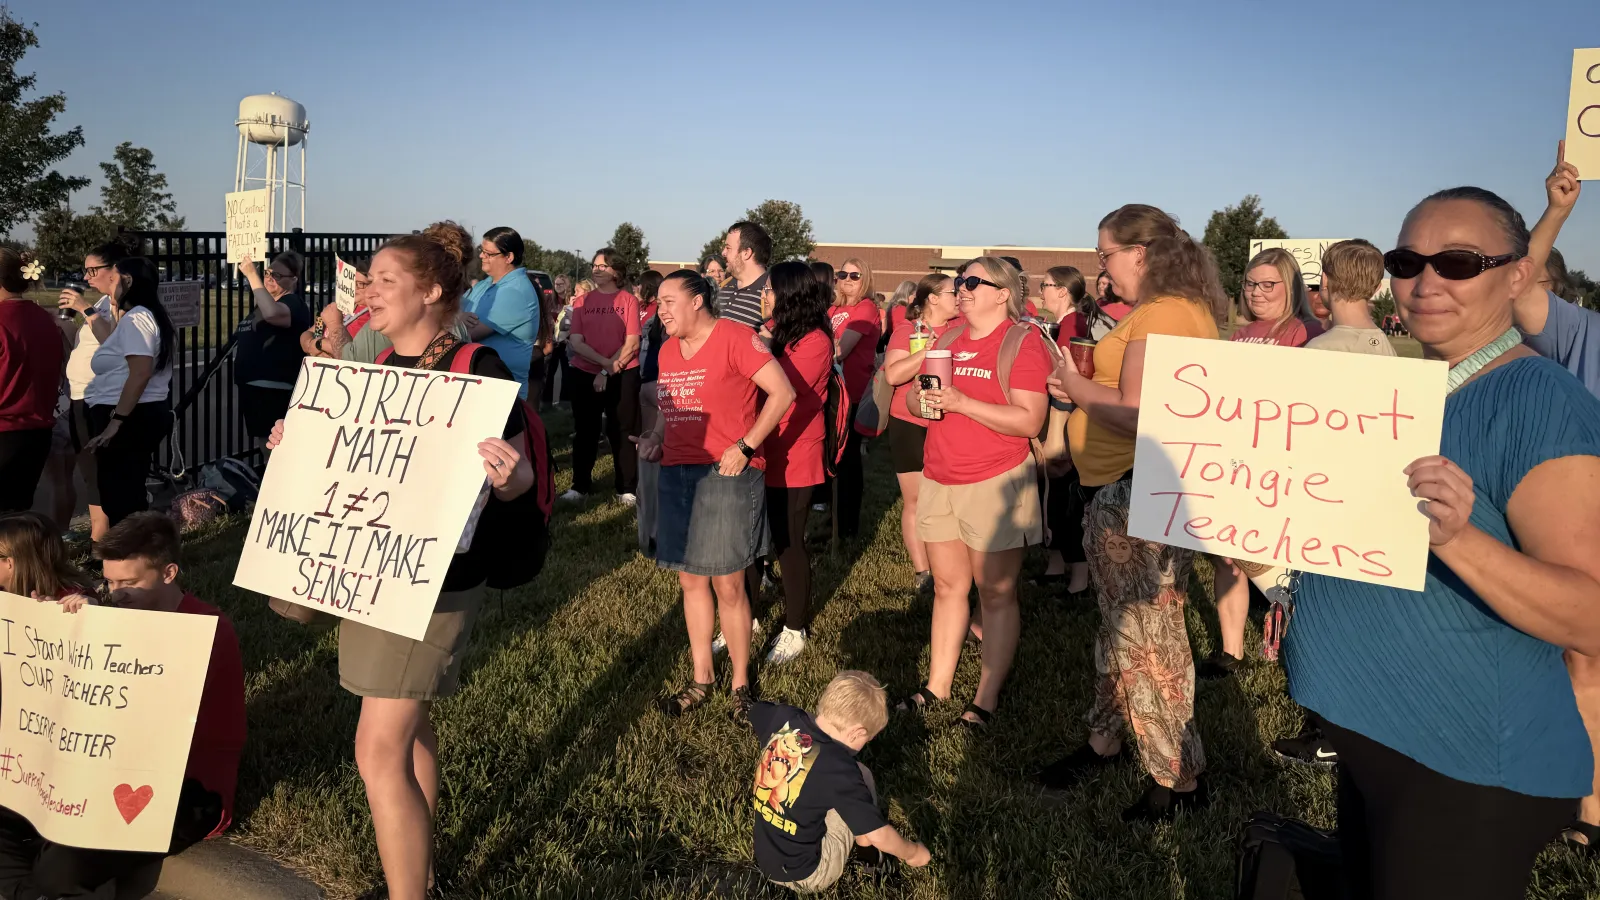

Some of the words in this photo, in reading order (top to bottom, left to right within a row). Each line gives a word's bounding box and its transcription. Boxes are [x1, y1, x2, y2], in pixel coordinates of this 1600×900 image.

[227, 199, 238, 217] NO
[228, 215, 250, 230] That's
[228, 231, 261, 248] FAILING
[343, 267, 356, 280] Our
[584, 306, 625, 316] WARRIORS
[289, 358, 482, 429] DISTRICT
[671, 388, 678, 396] is
[680, 387, 695, 398] Love
[954, 366, 993, 380] NATION
[1164, 362, 1415, 452] Support
[325, 425, 418, 485] MATH
[1161, 441, 1344, 508] Tongie
[256, 507, 321, 557] MAKE
[318, 522, 363, 565] IT
[360, 529, 438, 586] MAKE
[1149, 491, 1393, 578] Teachers
[292, 556, 383, 616] SENSE!
[1, 618, 16, 656] I
[24, 625, 64, 660] Stand
[68, 640, 93, 670] With
[103, 643, 164, 675] Teachers
[20, 661, 54, 694] OUR
[62, 674, 129, 709] TEACHERS
[19, 708, 56, 743] DESERVE
[58, 727, 117, 759] BETTER
